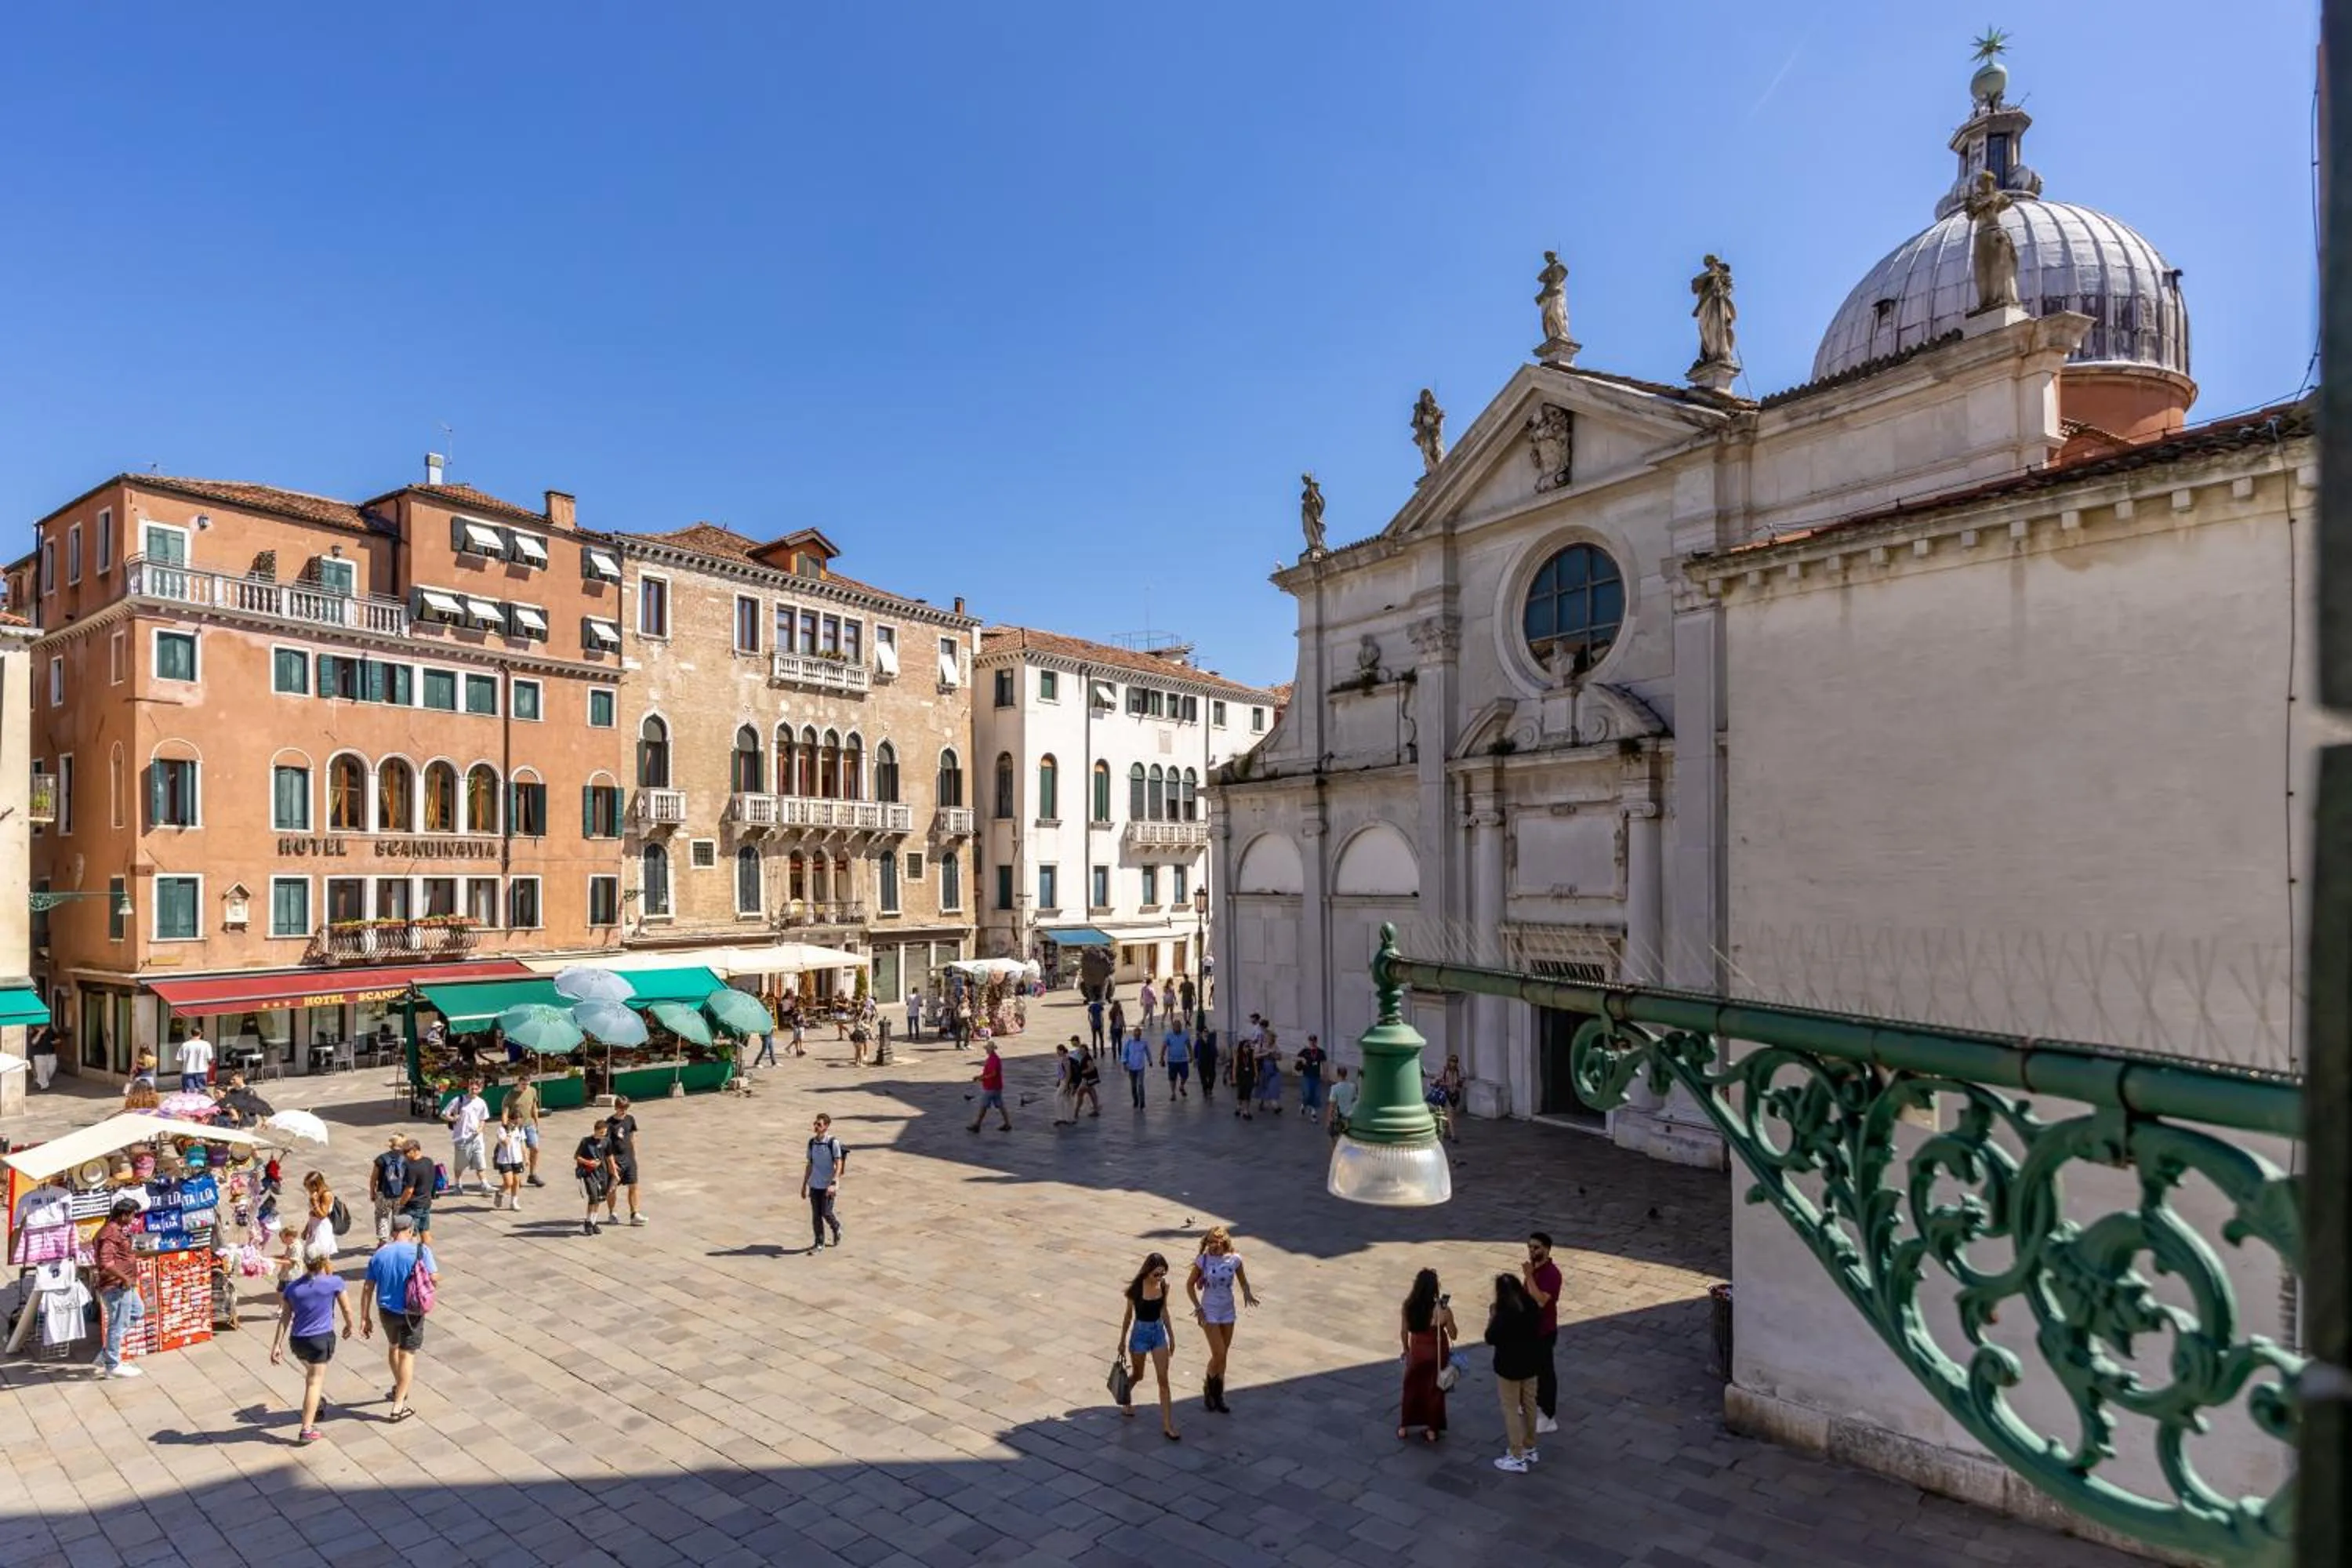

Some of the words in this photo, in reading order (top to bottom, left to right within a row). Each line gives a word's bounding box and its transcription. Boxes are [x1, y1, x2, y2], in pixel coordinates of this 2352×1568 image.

[277, 837, 347, 857] HOTEL
[373, 839, 498, 859] SCANDINAVIA
[303, 993, 346, 1007] HOTEL
[358, 988, 407, 1002] SCAND
